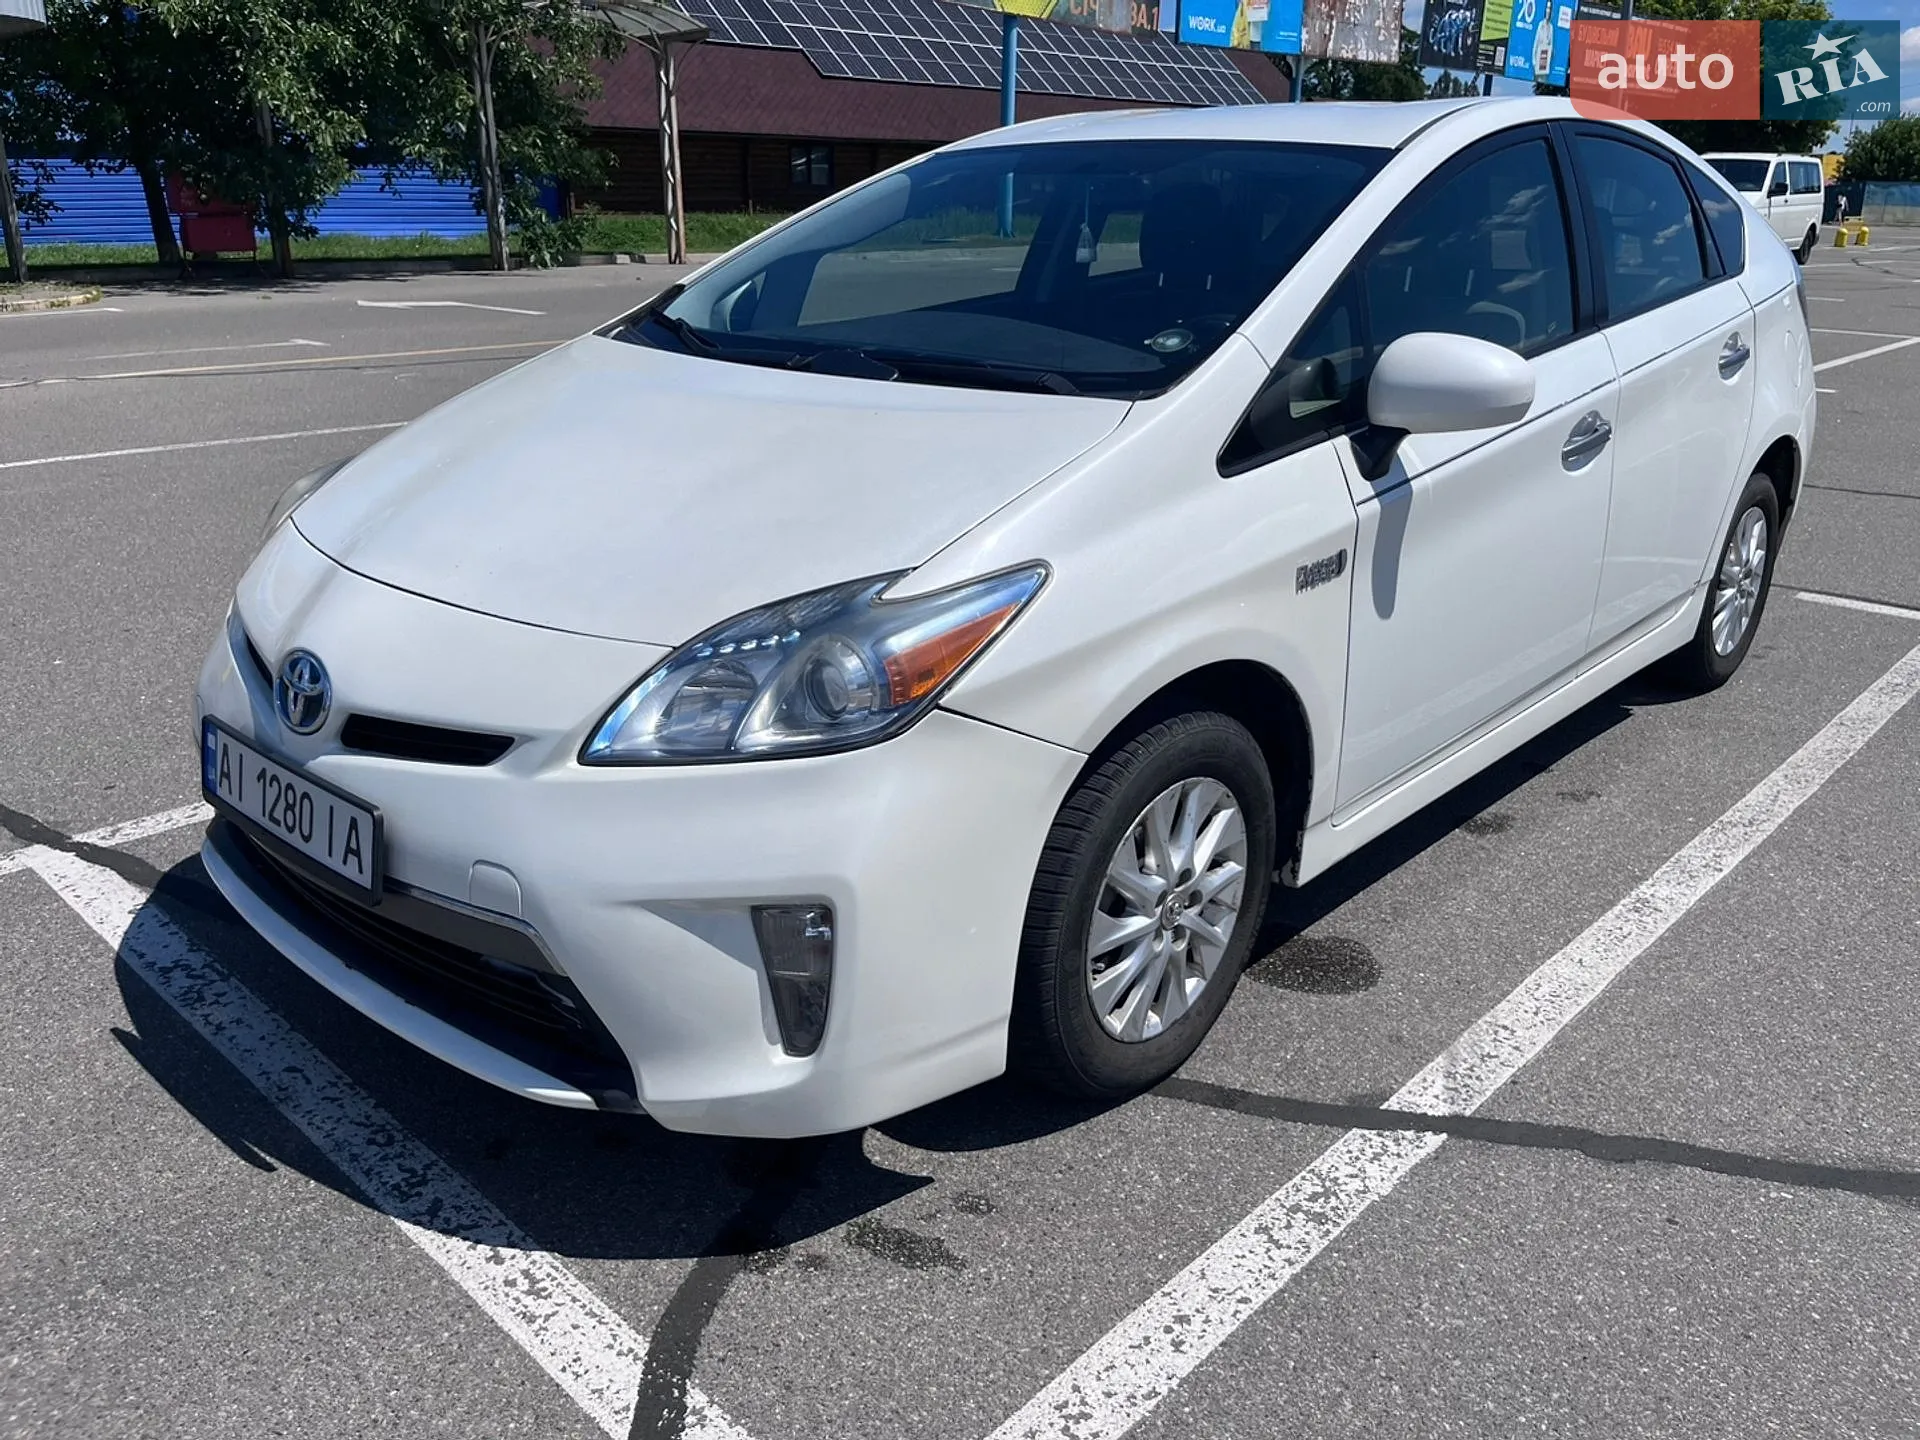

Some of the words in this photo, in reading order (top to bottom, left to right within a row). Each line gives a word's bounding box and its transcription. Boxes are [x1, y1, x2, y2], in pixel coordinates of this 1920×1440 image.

[218, 743, 243, 802] AI
[256, 767, 314, 844] 1280
[328, 805, 364, 875] IA
